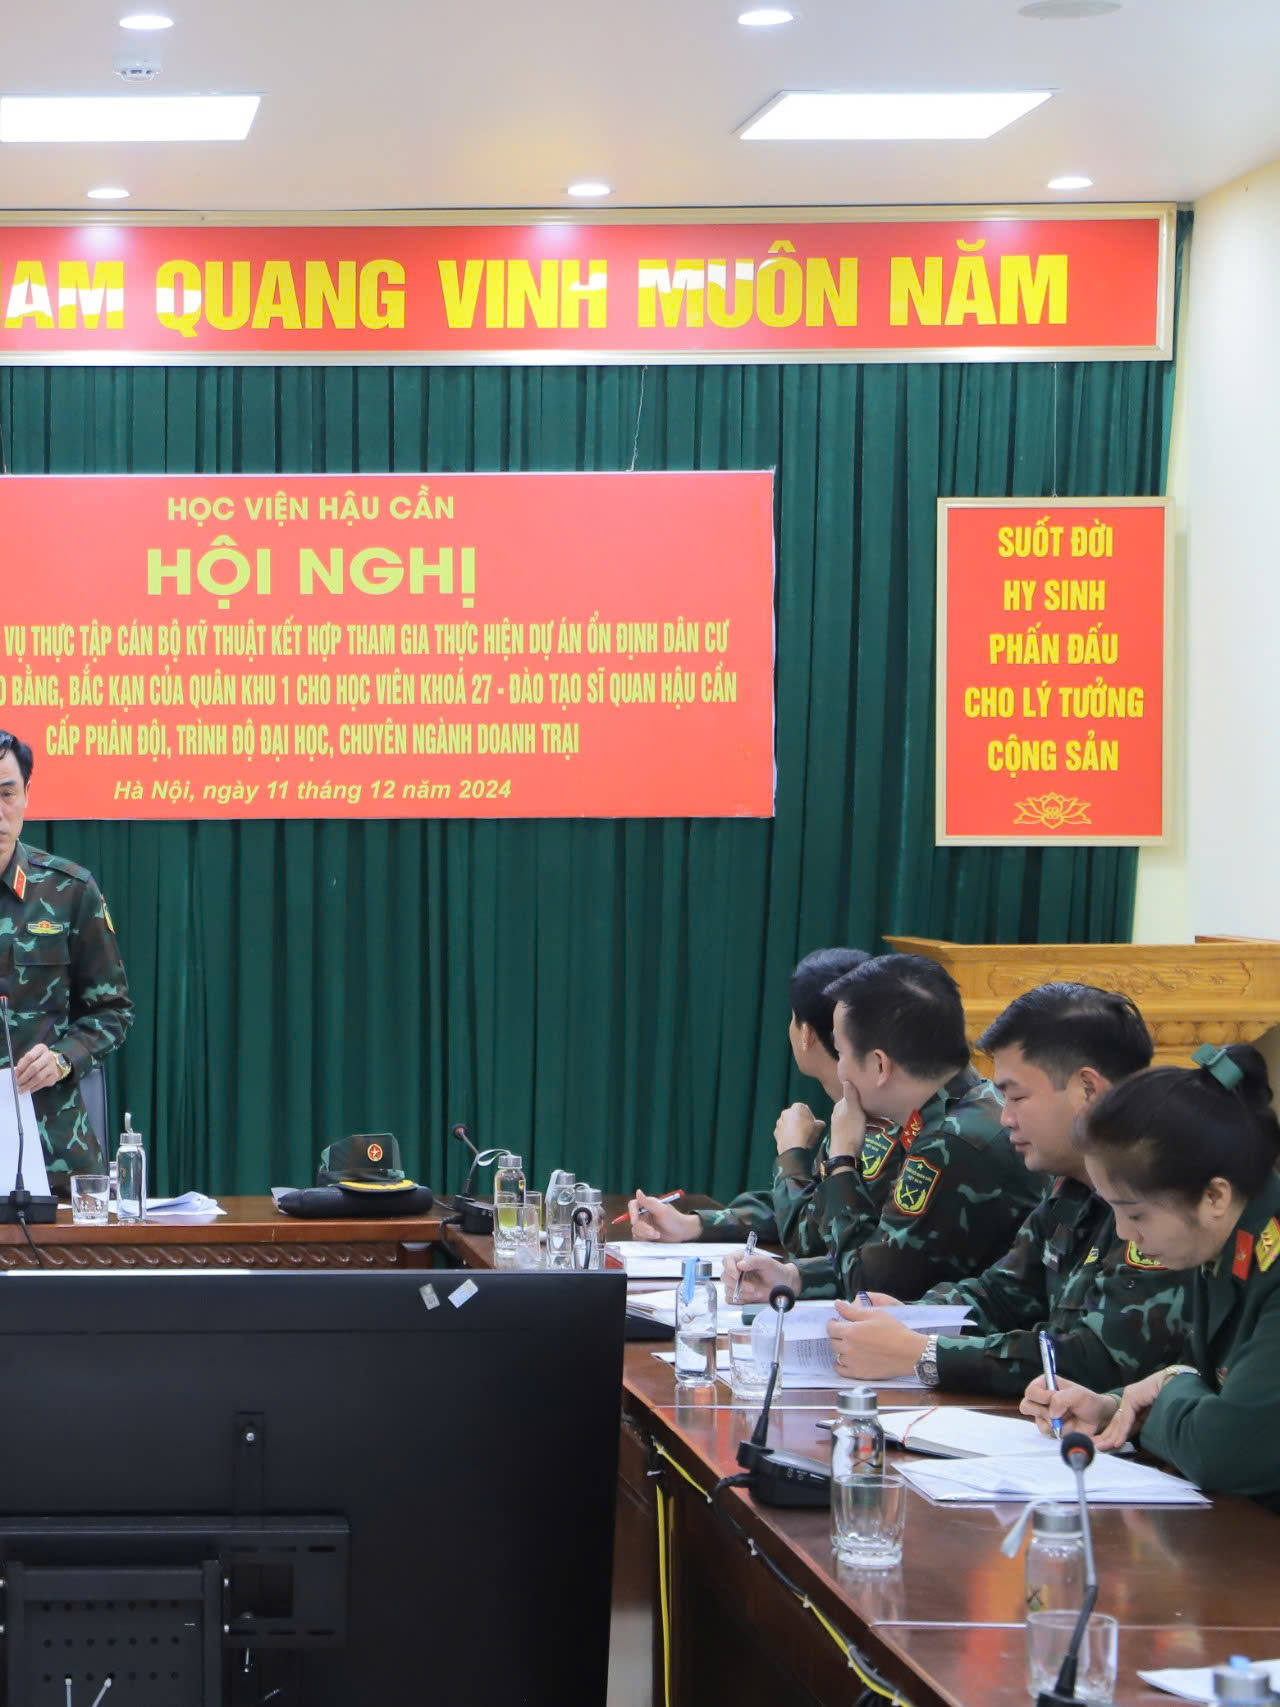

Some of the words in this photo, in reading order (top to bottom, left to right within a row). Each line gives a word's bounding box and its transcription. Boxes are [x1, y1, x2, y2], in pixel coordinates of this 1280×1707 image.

[155, 259, 406, 339] QUANG
[440, 259, 608, 330] VINH
[637, 240, 859, 329] MUÔN
[889, 239, 1068, 328] NĂM
[168, 497, 236, 527] HỌC
[244, 491, 309, 527] VIỆN
[320, 490, 380, 526] HẬU
[389, 484, 455, 521] CẦN
[998, 516, 1064, 558] SUỐT
[1070, 518, 1113, 558] ĐỜI
[147, 534, 272, 609] HỘI
[299, 546, 476, 609] NGHỊ
[1003, 579, 1037, 611] HY
[1043, 579, 1106, 611] SINH
[4, 626, 26, 663] VỤ
[31, 623, 75, 662] THỰC
[79, 619, 112, 662] TẬP
[118, 619, 153, 656] CÁN
[158, 619, 181, 662] BỘ
[186, 619, 208, 656] KỸ
[213, 618, 266, 662] THUẬT
[271, 615, 302, 656] KẾT
[307, 621, 342, 661] HỢP
[347, 624, 395, 655] THAM
[401, 624, 430, 655] GIA
[434, 620, 478, 661] THỰC
[484, 617, 524, 661] HIỆN
[529, 619, 553, 660] DỰ
[557, 617, 582, 654] ÁN
[587, 610, 611, 654] ỔN
[616, 623, 658, 660] ĐỊNH
[664, 616, 699, 653] DÂN
[705, 619, 731, 653] CƯ
[990, 621, 1060, 665] PHẤN
[1067, 622, 1118, 665] ĐẤU
[12, 664, 64, 709] BẰNG,
[69, 664, 104, 707] BẮC
[109, 675, 144, 712] KẠN
[150, 665, 185, 705] CỦA
[189, 668, 236, 710] QUÂN
[241, 674, 276, 705] KHU
[281, 675, 289, 705] 1
[296, 674, 331, 705] CHO
[336, 674, 371, 712] HỌC
[376, 668, 415, 705] VIÊN
[420, 668, 466, 705] KHOÁ
[472, 674, 493, 705] 27
[498, 687, 505, 695] -
[509, 667, 544, 705] ĐÀO
[549, 673, 582, 711] TẠO
[587, 667, 605, 704] SĨ
[610, 672, 656, 708] QUAN
[661, 666, 696, 710] HẬU
[701, 661, 737, 703] CẦN
[964, 686, 1015, 719] CHO
[1022, 681, 1052, 718] LÝ
[1058, 676, 1145, 719] TƯỞNG
[46, 716, 80, 756] CẤP
[86, 719, 132, 756] PHÂN
[137, 718, 172, 762] ĐỘI,
[176, 718, 227, 756] TRÌNH
[232, 718, 255, 761] ĐỘ
[260, 724, 290, 761] ĐẠI
[295, 724, 334, 761] HỌC,
[339, 717, 407, 756] CHUYÊN
[413, 717, 472, 755] NGÀNH
[477, 723, 536, 755] DOANH
[541, 723, 580, 761] TRẠI
[987, 734, 1057, 778] CỘNG
[1065, 730, 1119, 772] SẢN
[113, 780, 144, 801] Hà
[152, 780, 195, 805] Nội,
[203, 780, 260, 805] ngày
[267, 780, 289, 800] 11
[298, 779, 363, 805] tháng
[371, 780, 396, 799] 12
[402, 779, 452, 799] năm
[458, 779, 512, 799] 2024
